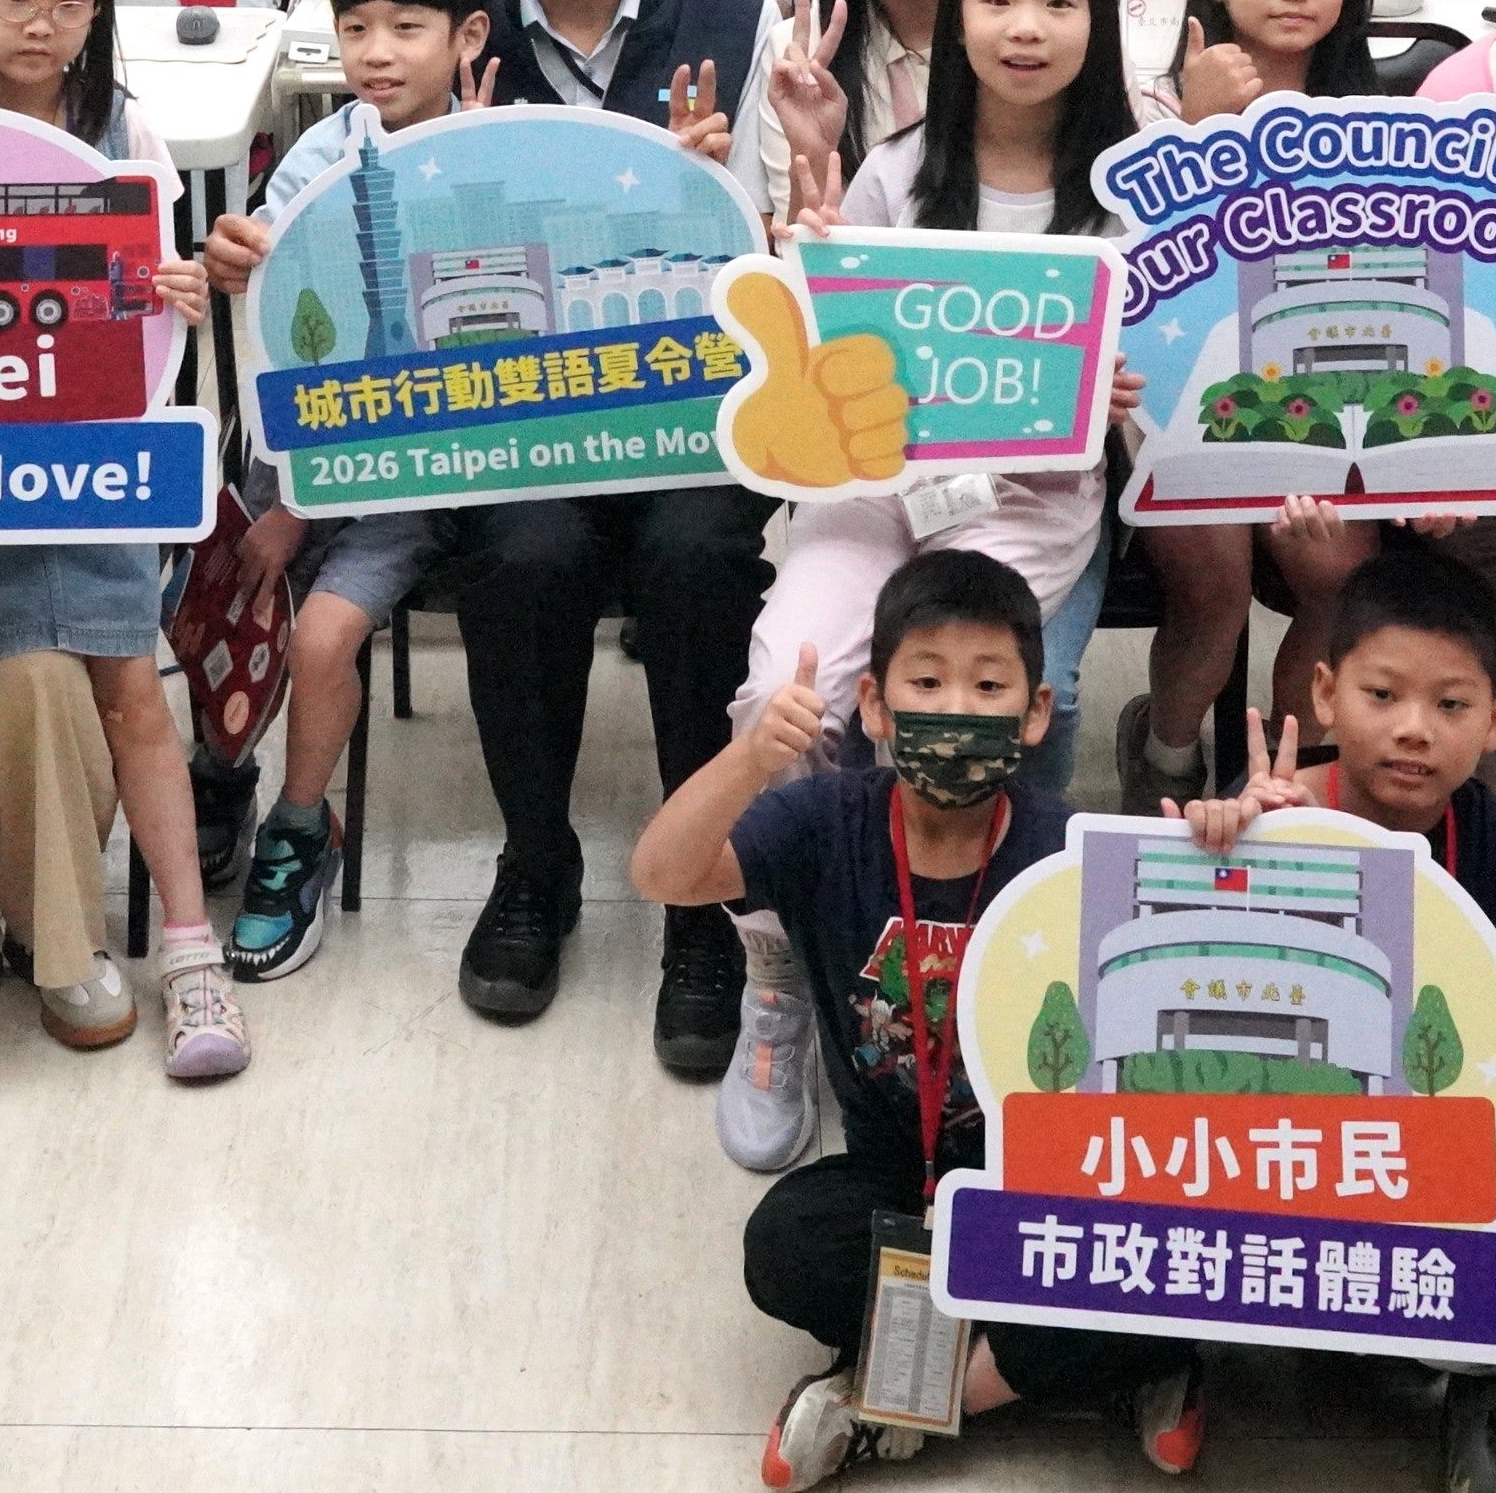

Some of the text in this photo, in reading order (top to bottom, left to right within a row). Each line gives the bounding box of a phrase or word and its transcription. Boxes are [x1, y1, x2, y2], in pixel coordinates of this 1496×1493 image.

[1115, 134, 1251, 218] The
[893, 282, 1075, 340] GOOD
[293, 330, 746, 432] 城市行動雙語夏令營
[917, 356, 1043, 407] JOB!
[309, 449, 400, 487] 2026
[407, 437, 521, 481] Taipei
[529, 439, 576, 468] on
[583, 430, 647, 462] the
[1080, 1116, 1411, 1201] 小小市民
[1018, 1214, 1458, 1322] 市政對話體驗
